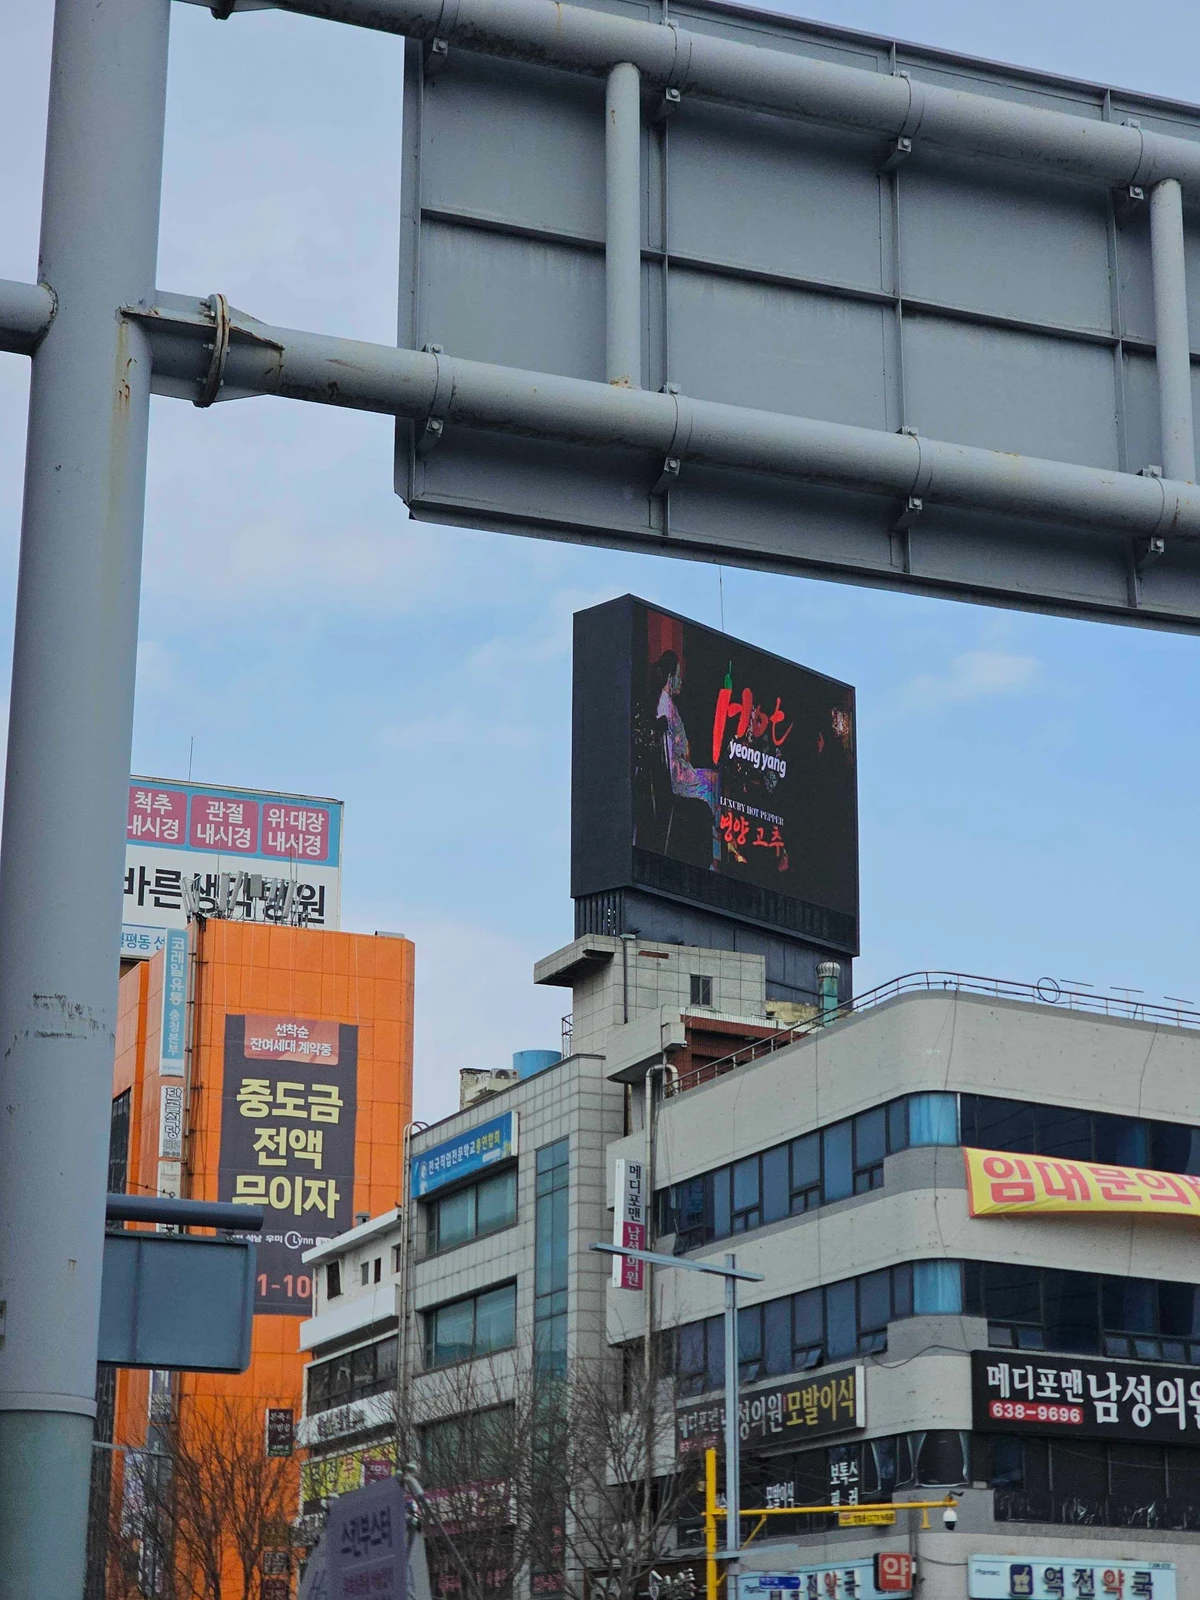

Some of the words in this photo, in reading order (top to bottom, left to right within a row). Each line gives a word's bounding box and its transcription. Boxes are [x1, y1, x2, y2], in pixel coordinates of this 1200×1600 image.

[713, 688, 793, 765] Hot
[729, 738, 764, 768] yeong
[761, 752, 787, 778] yang
[134, 791, 173, 815] 척추
[206, 800, 244, 824] 관절
[720, 796, 746, 812] LUXURY
[746, 806, 760, 818] HOT
[760, 810, 784, 827] PEPPER
[127, 814, 179, 840] 내시경
[196, 823, 251, 849] 내시경
[267, 808, 325, 834] 위·대장
[267, 831, 321, 856] 내시경
[752, 824, 785, 857] 고추
[169, 936, 184, 1006] 코레일유통
[250, 1037, 296, 1053] 잔여세대
[298, 1041, 332, 1057] 계약중
[275, 1023, 310, 1039] 선착순
[236, 1078, 344, 1124] 중도금
[252, 1127, 323, 1170] 전액
[232, 1175, 341, 1219] 무이자
[628, 1164, 642, 1222] 메디포맨
[982, 1156, 1193, 1206] 임대문의
[986, 1363, 1085, 1404] 메디포맨
[720, 1392, 784, 1442] 성의원
[786, 1375, 855, 1427] 모발이식
[991, 1403, 1081, 1424] 638-9696
[830, 1460, 859, 1486] 보톡스
[883, 1557, 911, 1589] 약
[1043, 1566, 1154, 1600] 역전약국
